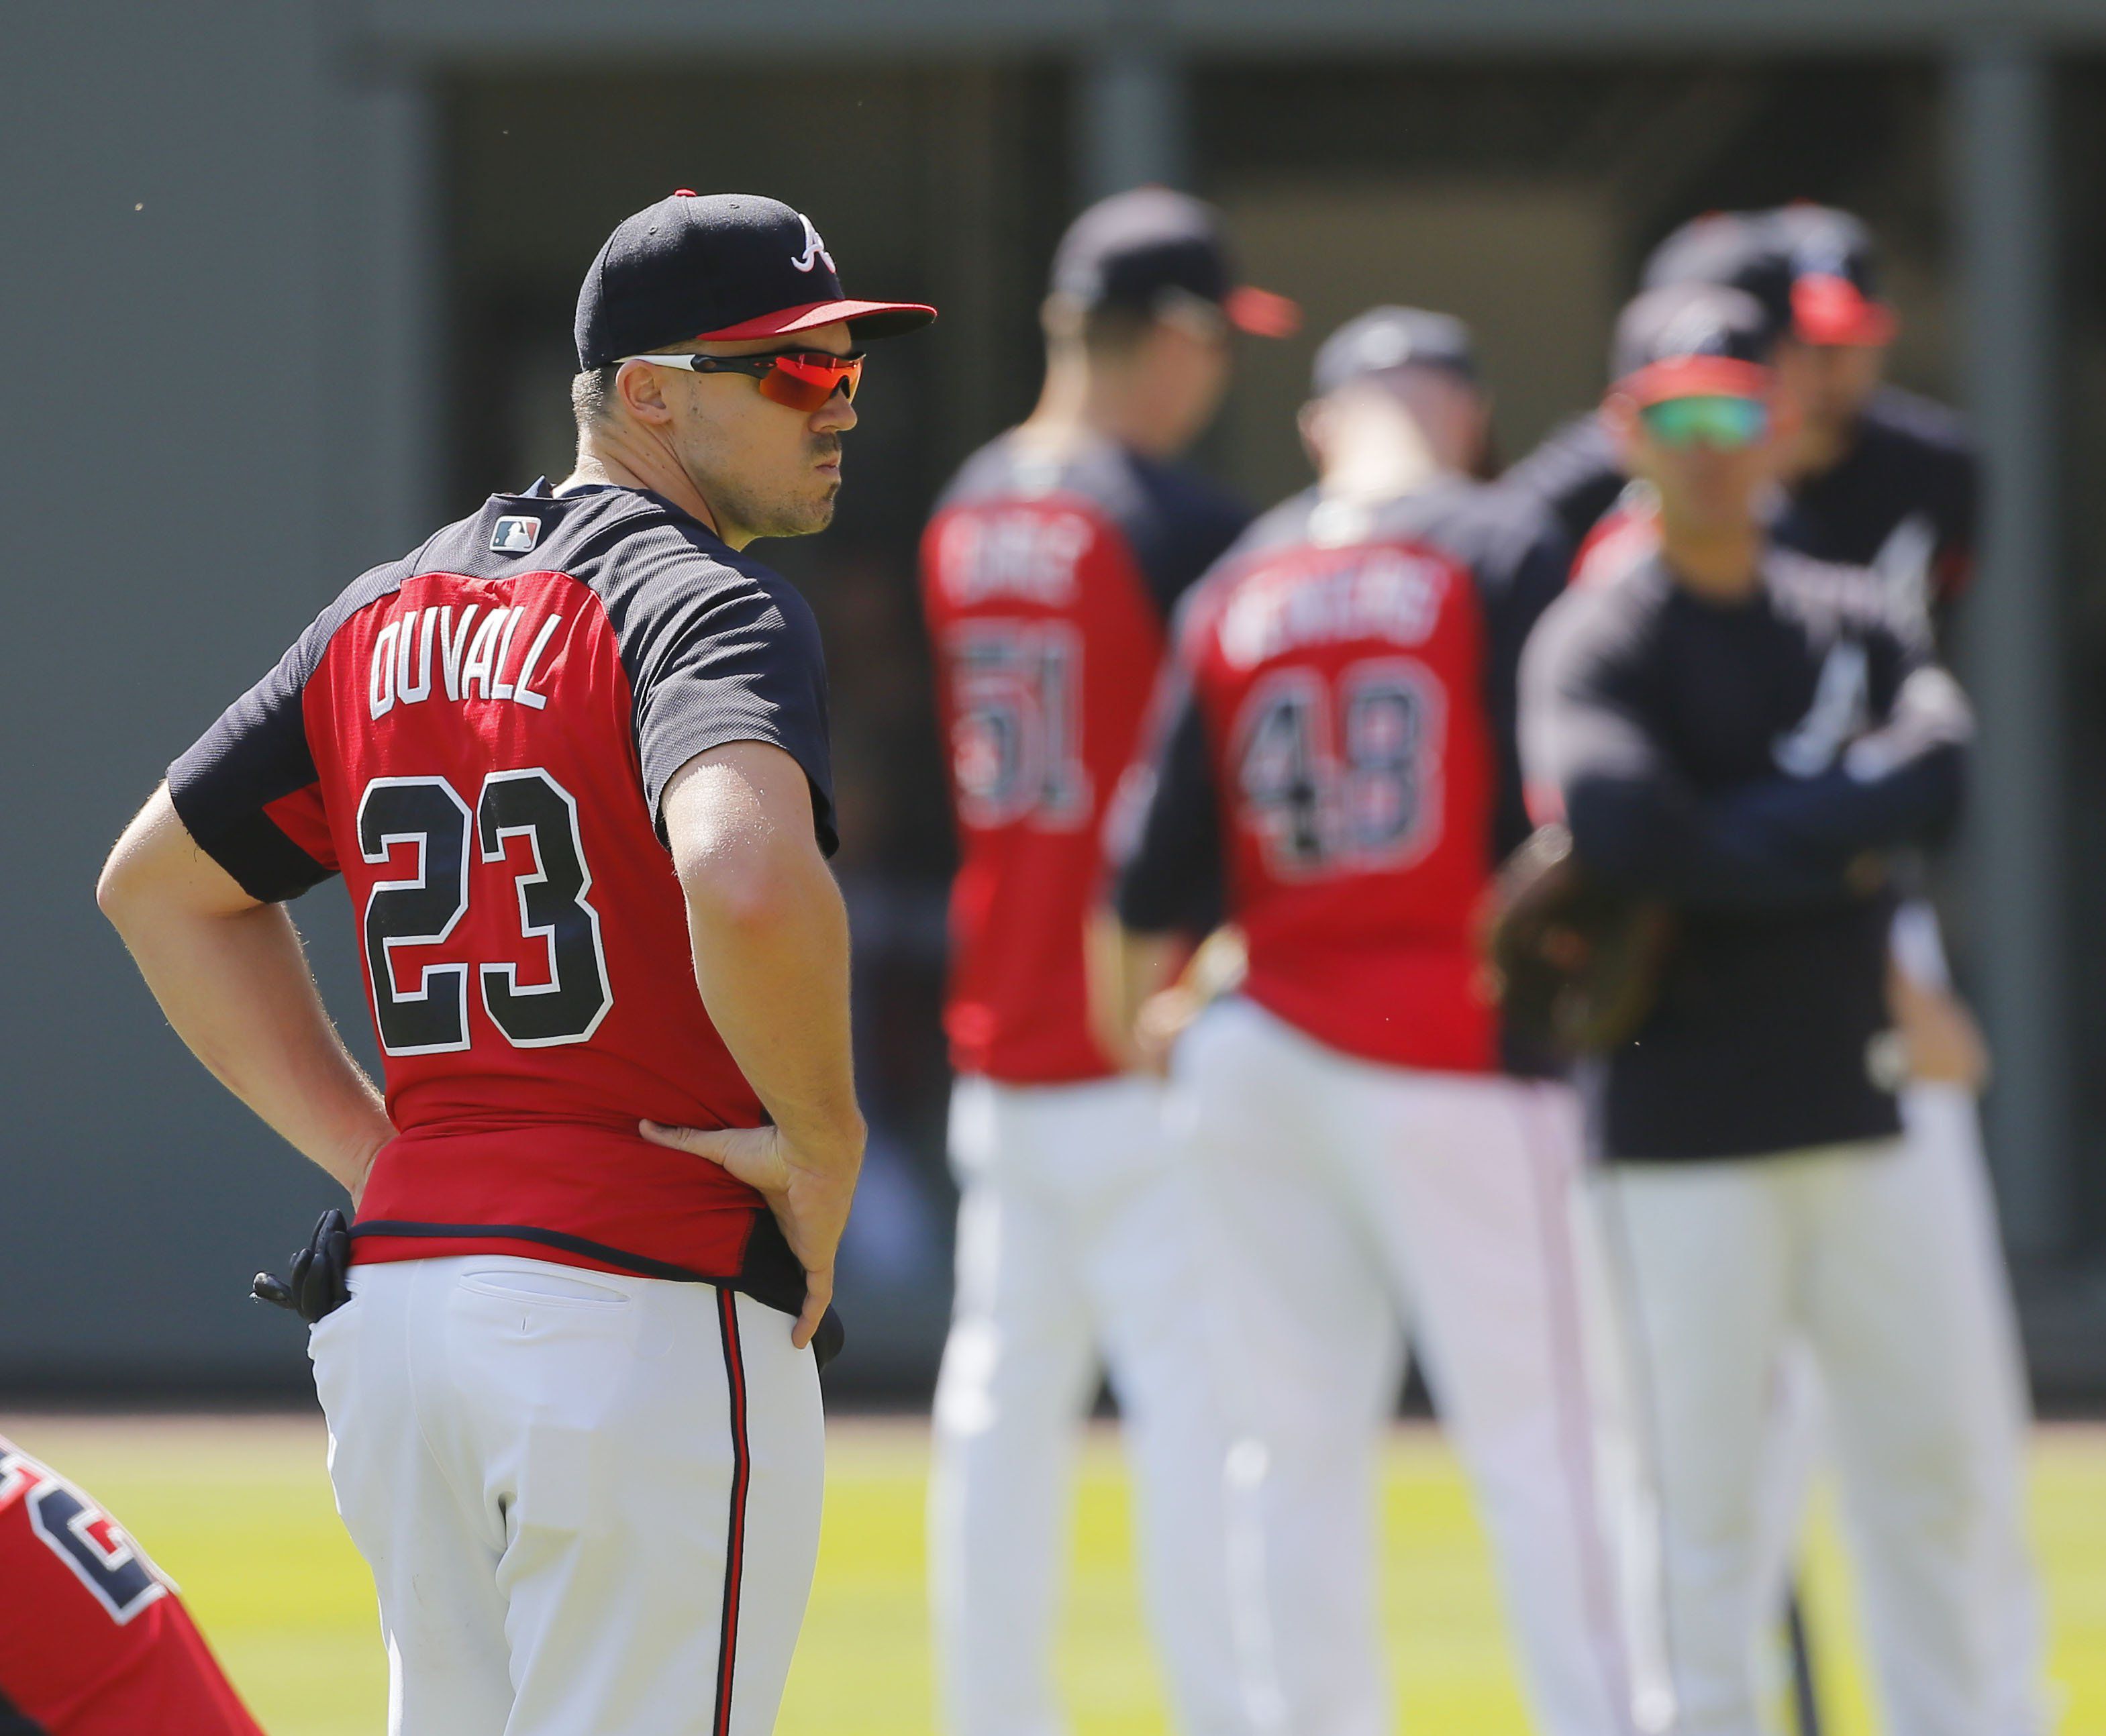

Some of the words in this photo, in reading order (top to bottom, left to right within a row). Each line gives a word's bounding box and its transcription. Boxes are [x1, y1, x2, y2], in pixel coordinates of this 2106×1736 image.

[369, 603, 562, 721] DUVALL
[948, 617, 1095, 833] 51
[1231, 658, 1448, 882] 48
[356, 766, 614, 1057] 23
